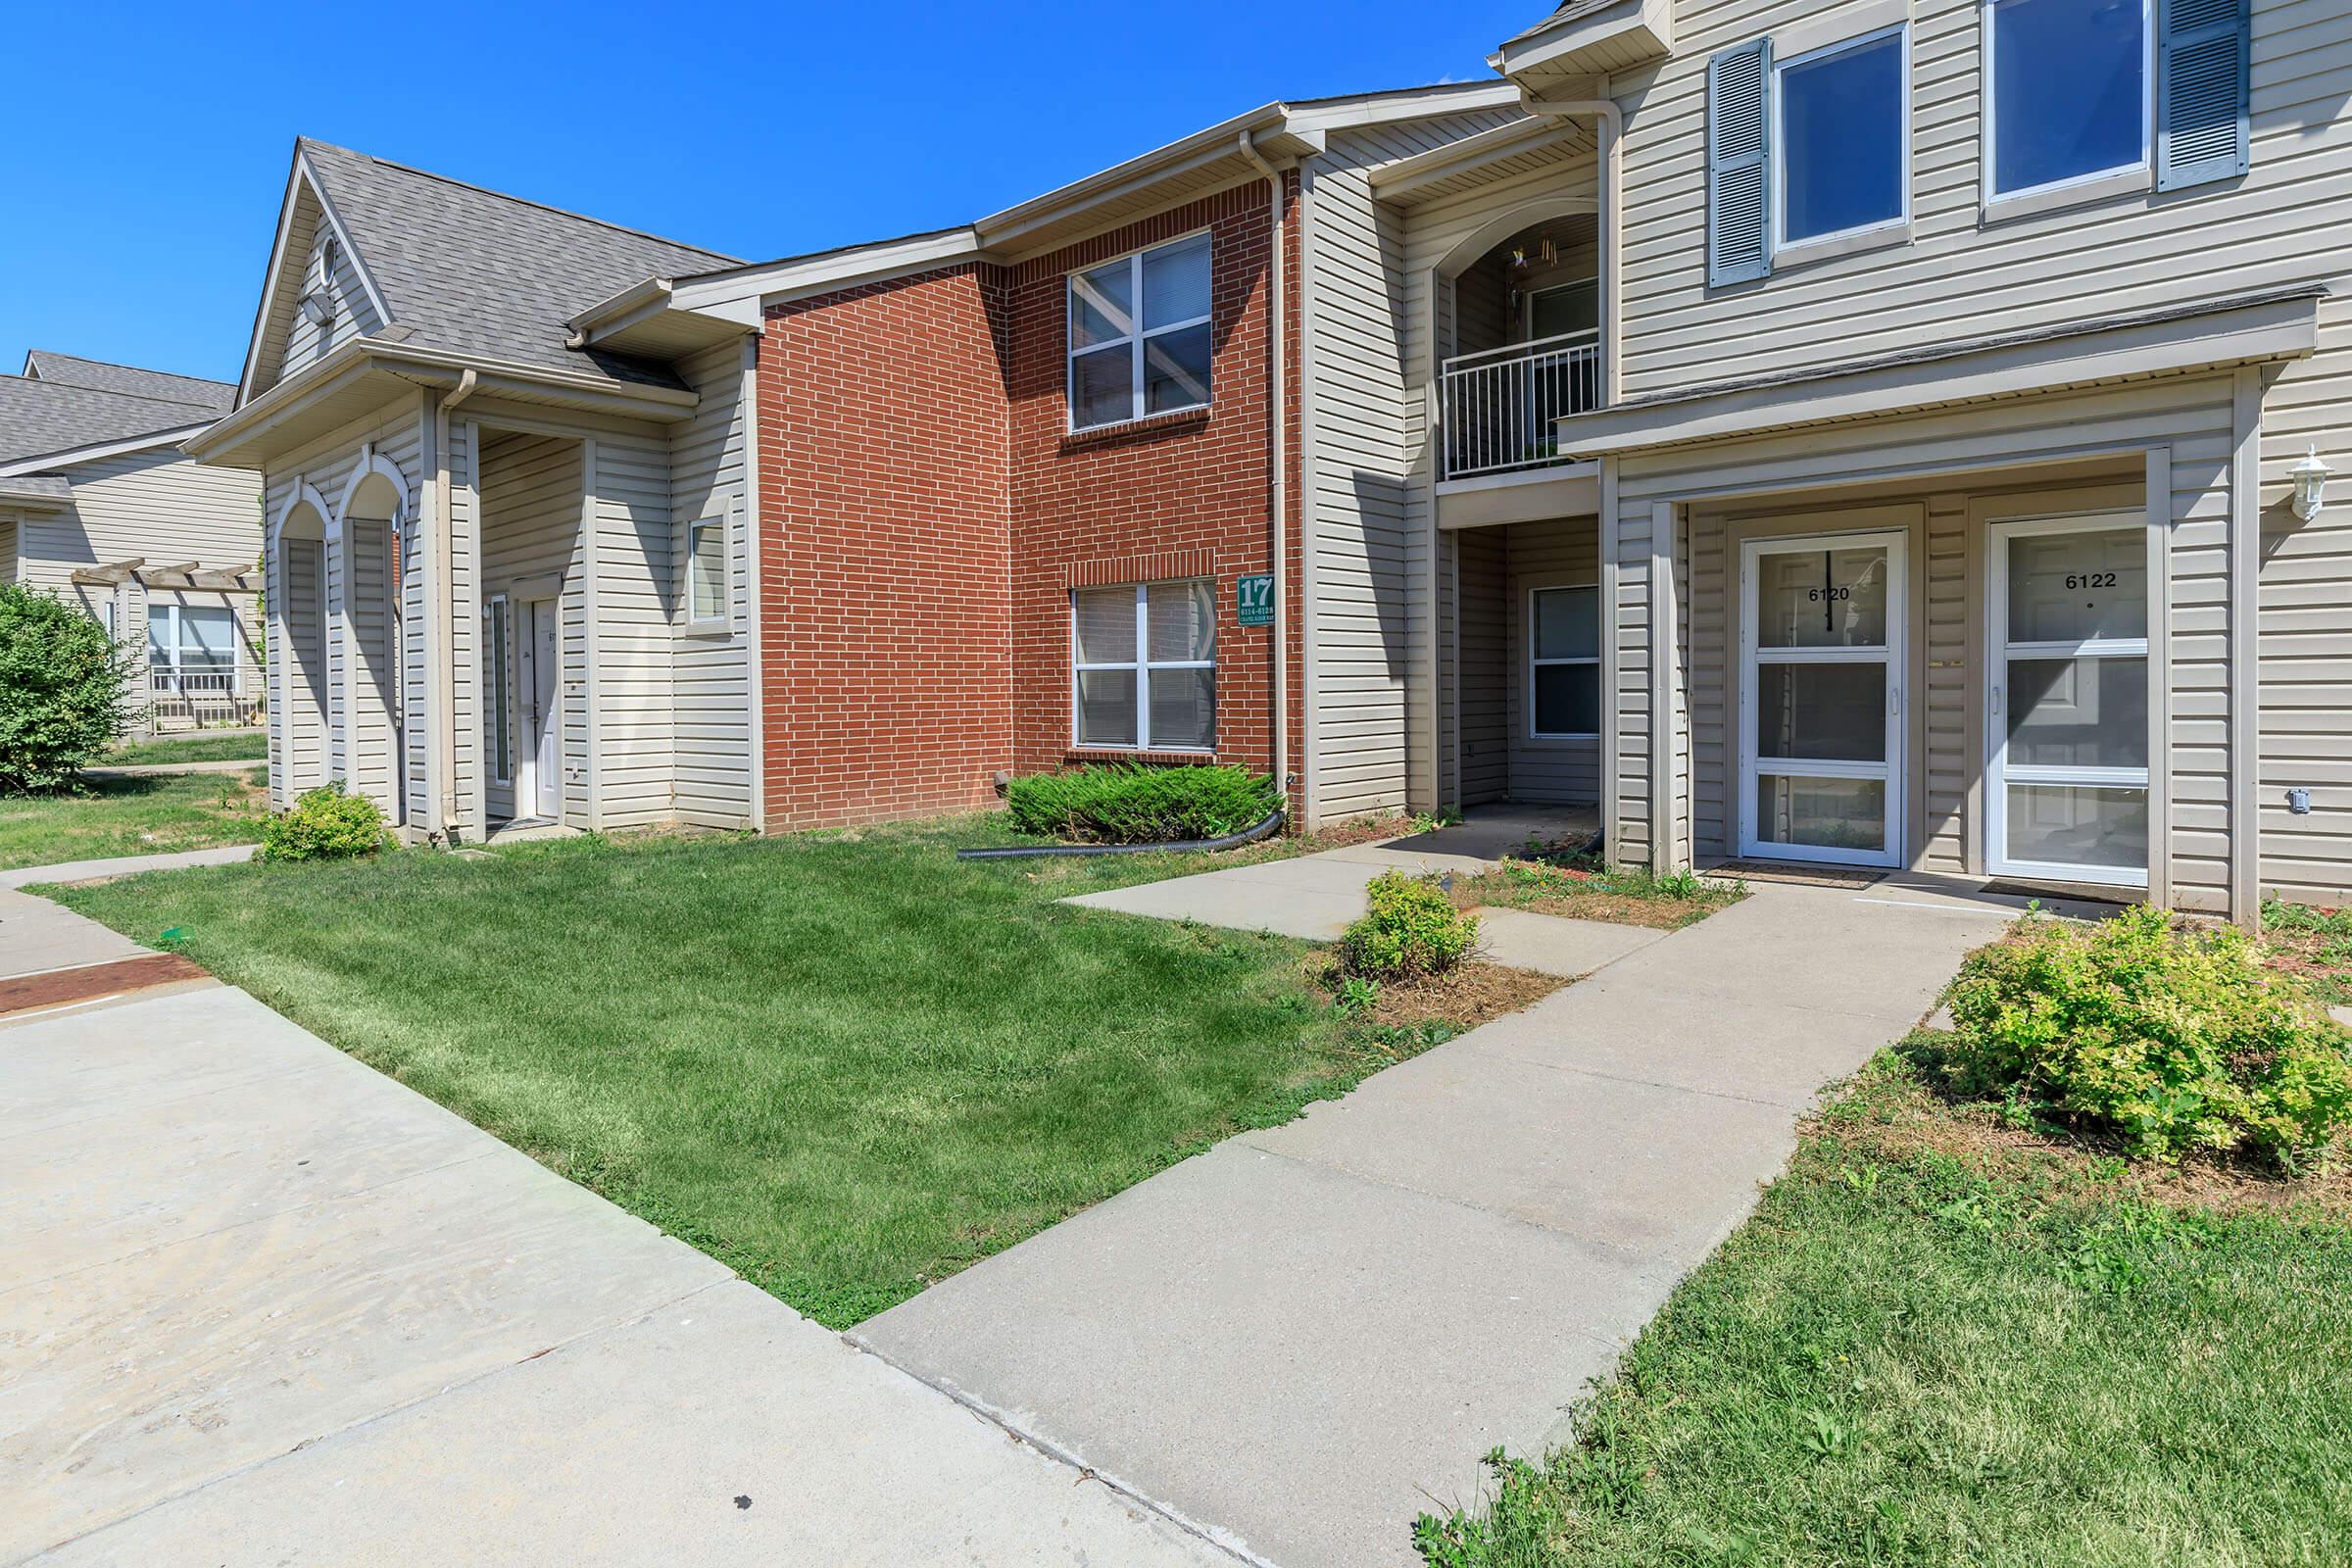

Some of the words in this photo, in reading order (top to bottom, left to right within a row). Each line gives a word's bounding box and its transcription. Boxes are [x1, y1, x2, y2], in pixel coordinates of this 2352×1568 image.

[2066, 572, 2117, 589] 6122
[1241, 578, 1273, 607] 17
[1809, 587, 1849, 602] 6120
